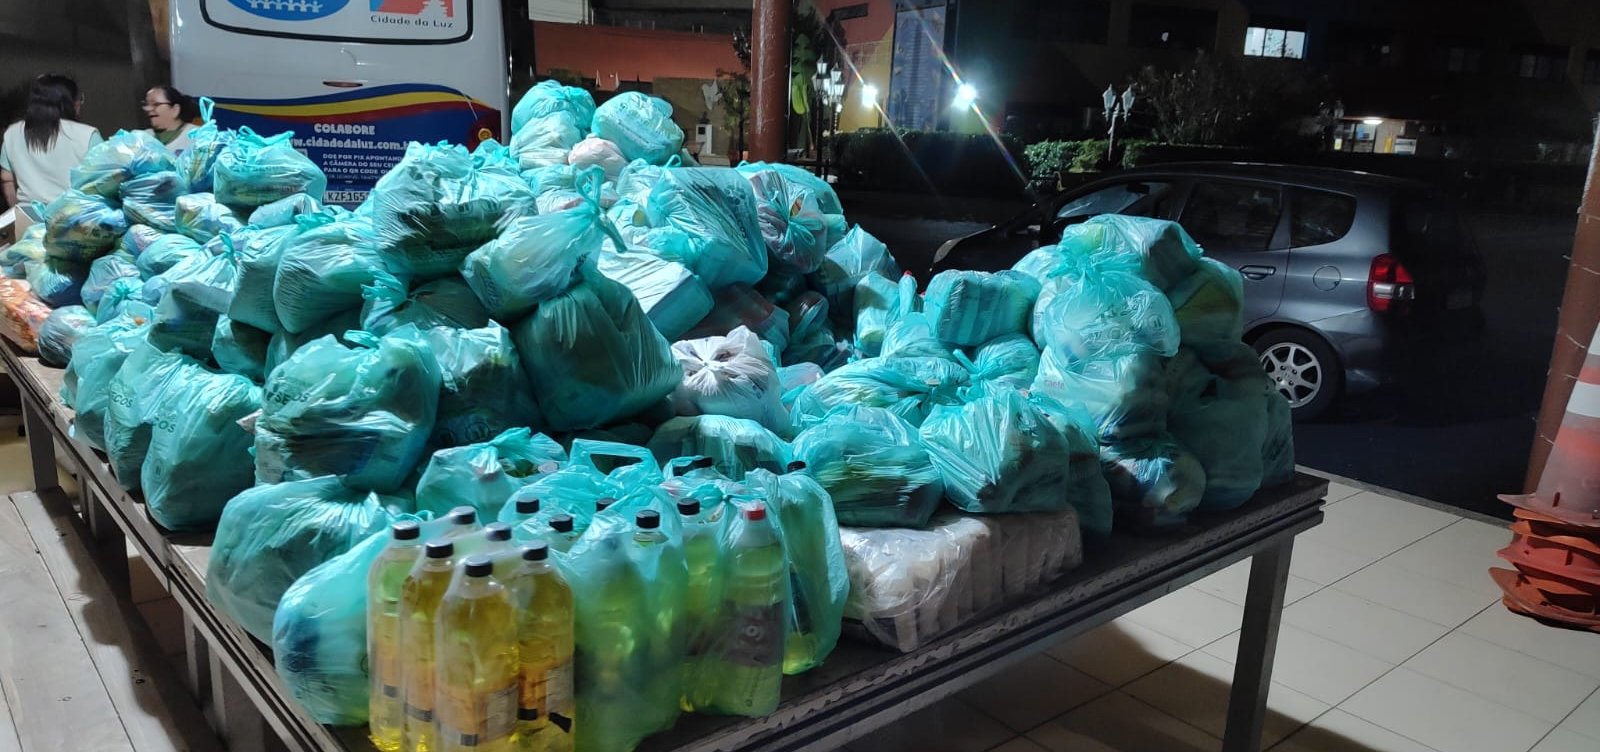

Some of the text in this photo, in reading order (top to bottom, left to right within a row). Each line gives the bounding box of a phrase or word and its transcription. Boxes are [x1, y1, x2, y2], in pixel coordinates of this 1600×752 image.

[370, 14, 454, 29] Cidade da Luz
[314, 123, 375, 135] COLABORE
[329, 159, 357, 167] CÂMERA
